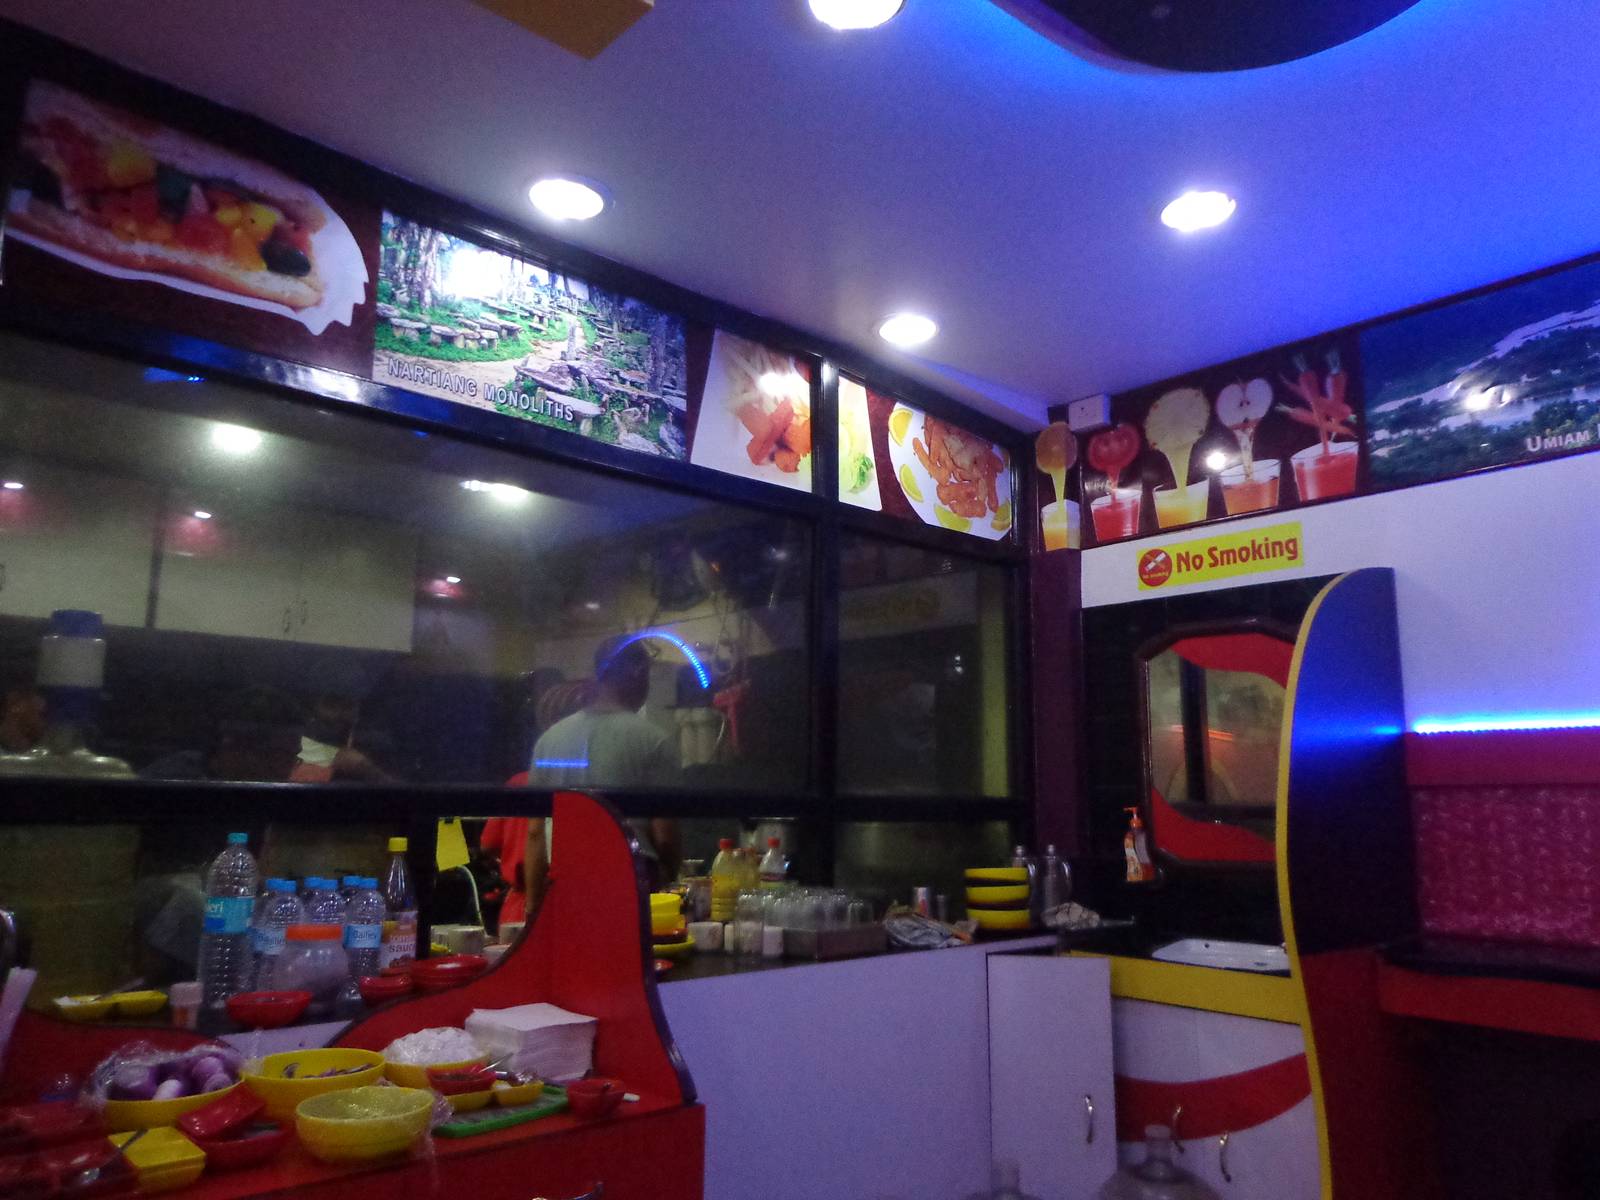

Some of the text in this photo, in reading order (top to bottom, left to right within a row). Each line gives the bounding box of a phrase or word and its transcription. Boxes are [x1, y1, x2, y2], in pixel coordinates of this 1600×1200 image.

[388, 358, 575, 422] NARTIANG MONOLITHS
[1526, 430, 1591, 452] UMIAM
[1176, 537, 1299, 573] No Smoking
